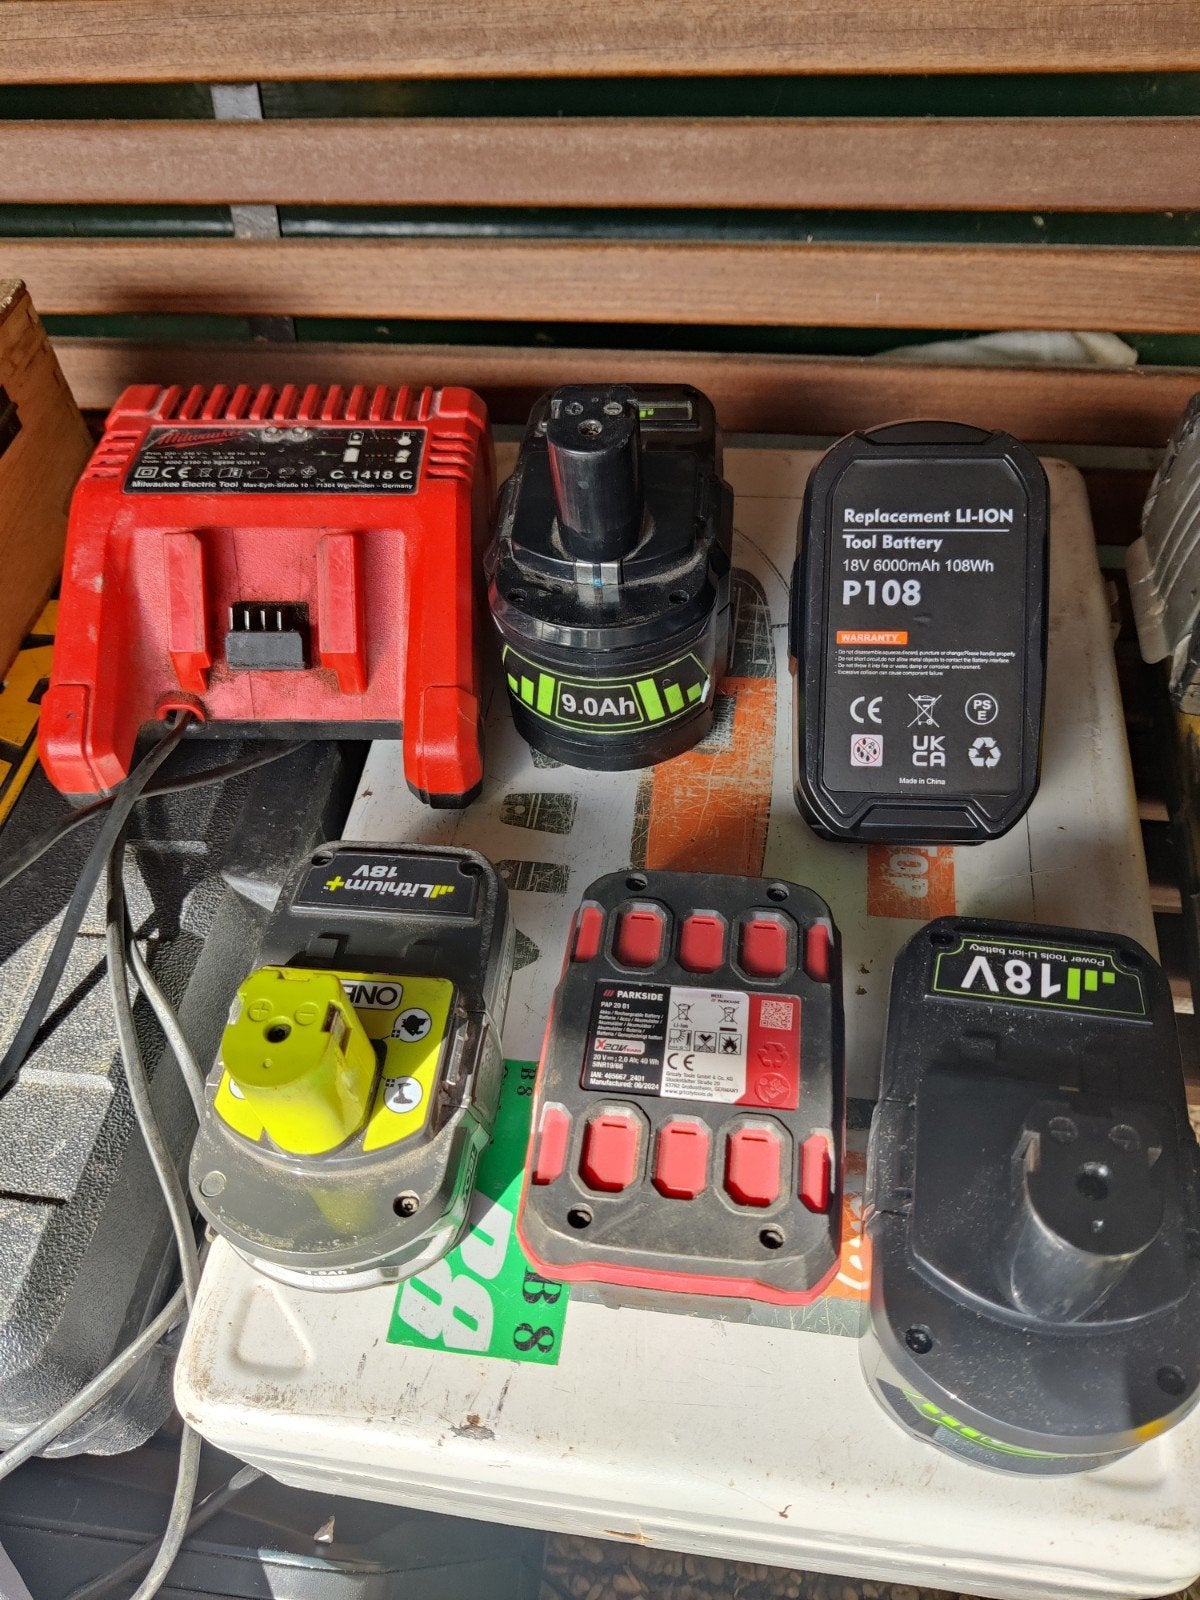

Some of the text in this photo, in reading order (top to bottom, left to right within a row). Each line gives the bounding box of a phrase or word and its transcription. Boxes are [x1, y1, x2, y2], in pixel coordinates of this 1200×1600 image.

[330, 470, 413, 480] C 1418 C
[844, 508, 1014, 526] Replacement LI-ION
[842, 534, 943, 552] Tool Battery
[843, 559, 994, 572] 18V 6000mAh 108Wh
[842, 579, 922, 606] P108
[841, 634, 899, 642] WARRANTY
[561, 693, 636, 717] 9.0Ah
[899, 777, 917, 785] Made
[926, 777, 946, 785] China
[352, 864, 398, 879] 18V
[969, 943, 1105, 967] Power Tools Li-ion battery
[960, 955, 1062, 999] 18V
[616, 990, 664, 1001] PARKSIDE
[513, 1265, 562, 1354] B 8
